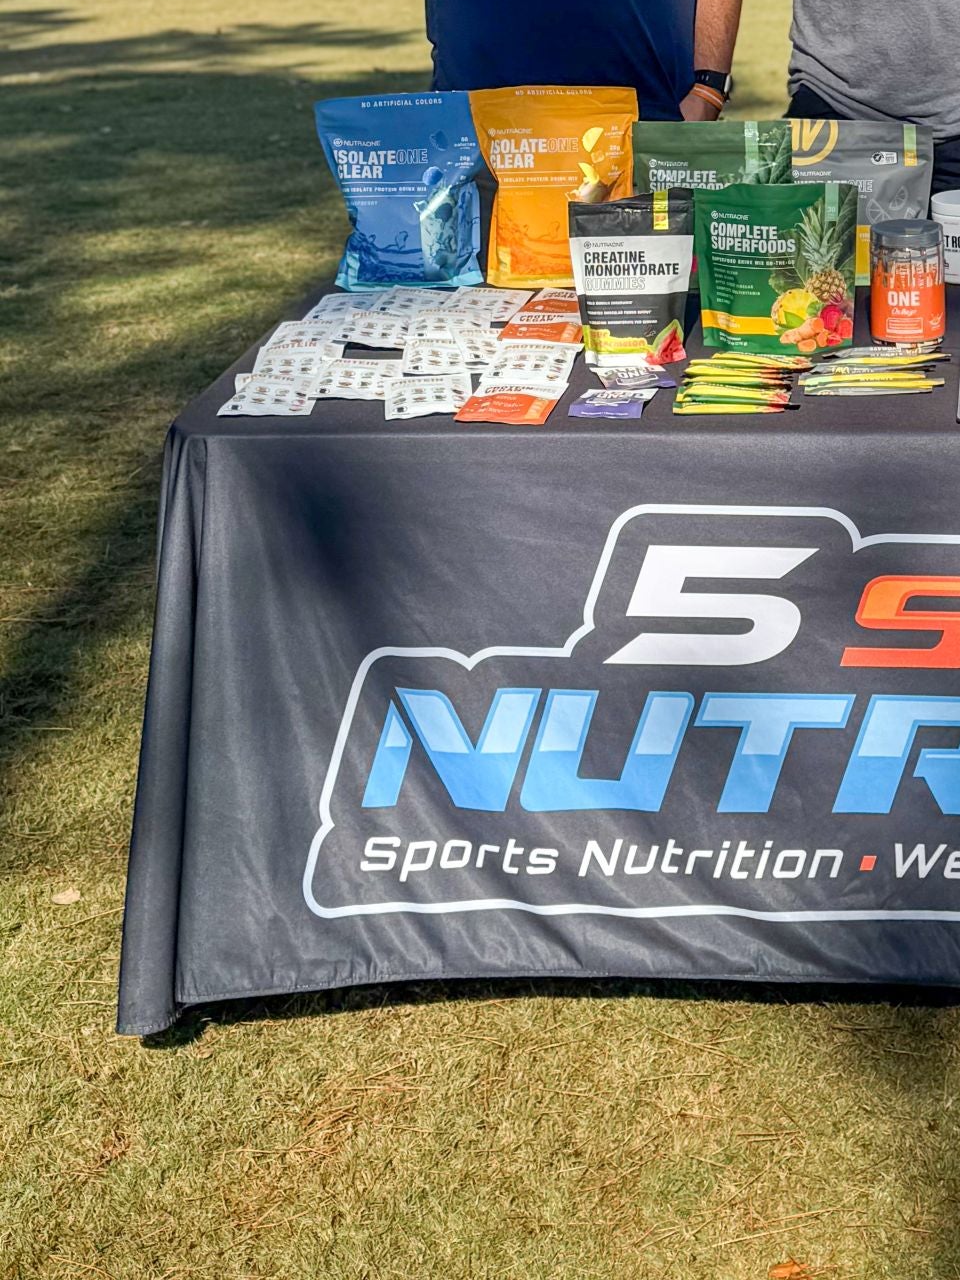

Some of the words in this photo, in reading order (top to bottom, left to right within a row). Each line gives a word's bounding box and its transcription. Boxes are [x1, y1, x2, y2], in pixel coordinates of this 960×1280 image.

[373, 99, 413, 107] ARTIFICIAL
[490, 137, 579, 153] ISOLATEONE
[334, 148, 429, 165] ISOLATEONE
[490, 153, 535, 169] CLEAR
[338, 165, 383, 179] CLEAR
[648, 169, 717, 183] COMPLETE
[718, 212, 749, 221] NUTRAONE
[710, 221, 778, 240] COMPLETE
[711, 236, 797, 254] SUPERFOODS
[584, 251, 646, 264] CREATINE
[584, 263, 680, 277] MONOHYDRATE
[585, 277, 646, 291] GUMMIES
[887, 290, 921, 307] ONE
[602, 545, 820, 666] 5
[360, 836, 560, 882] Sports
[578, 838, 844, 880] Nutrition
